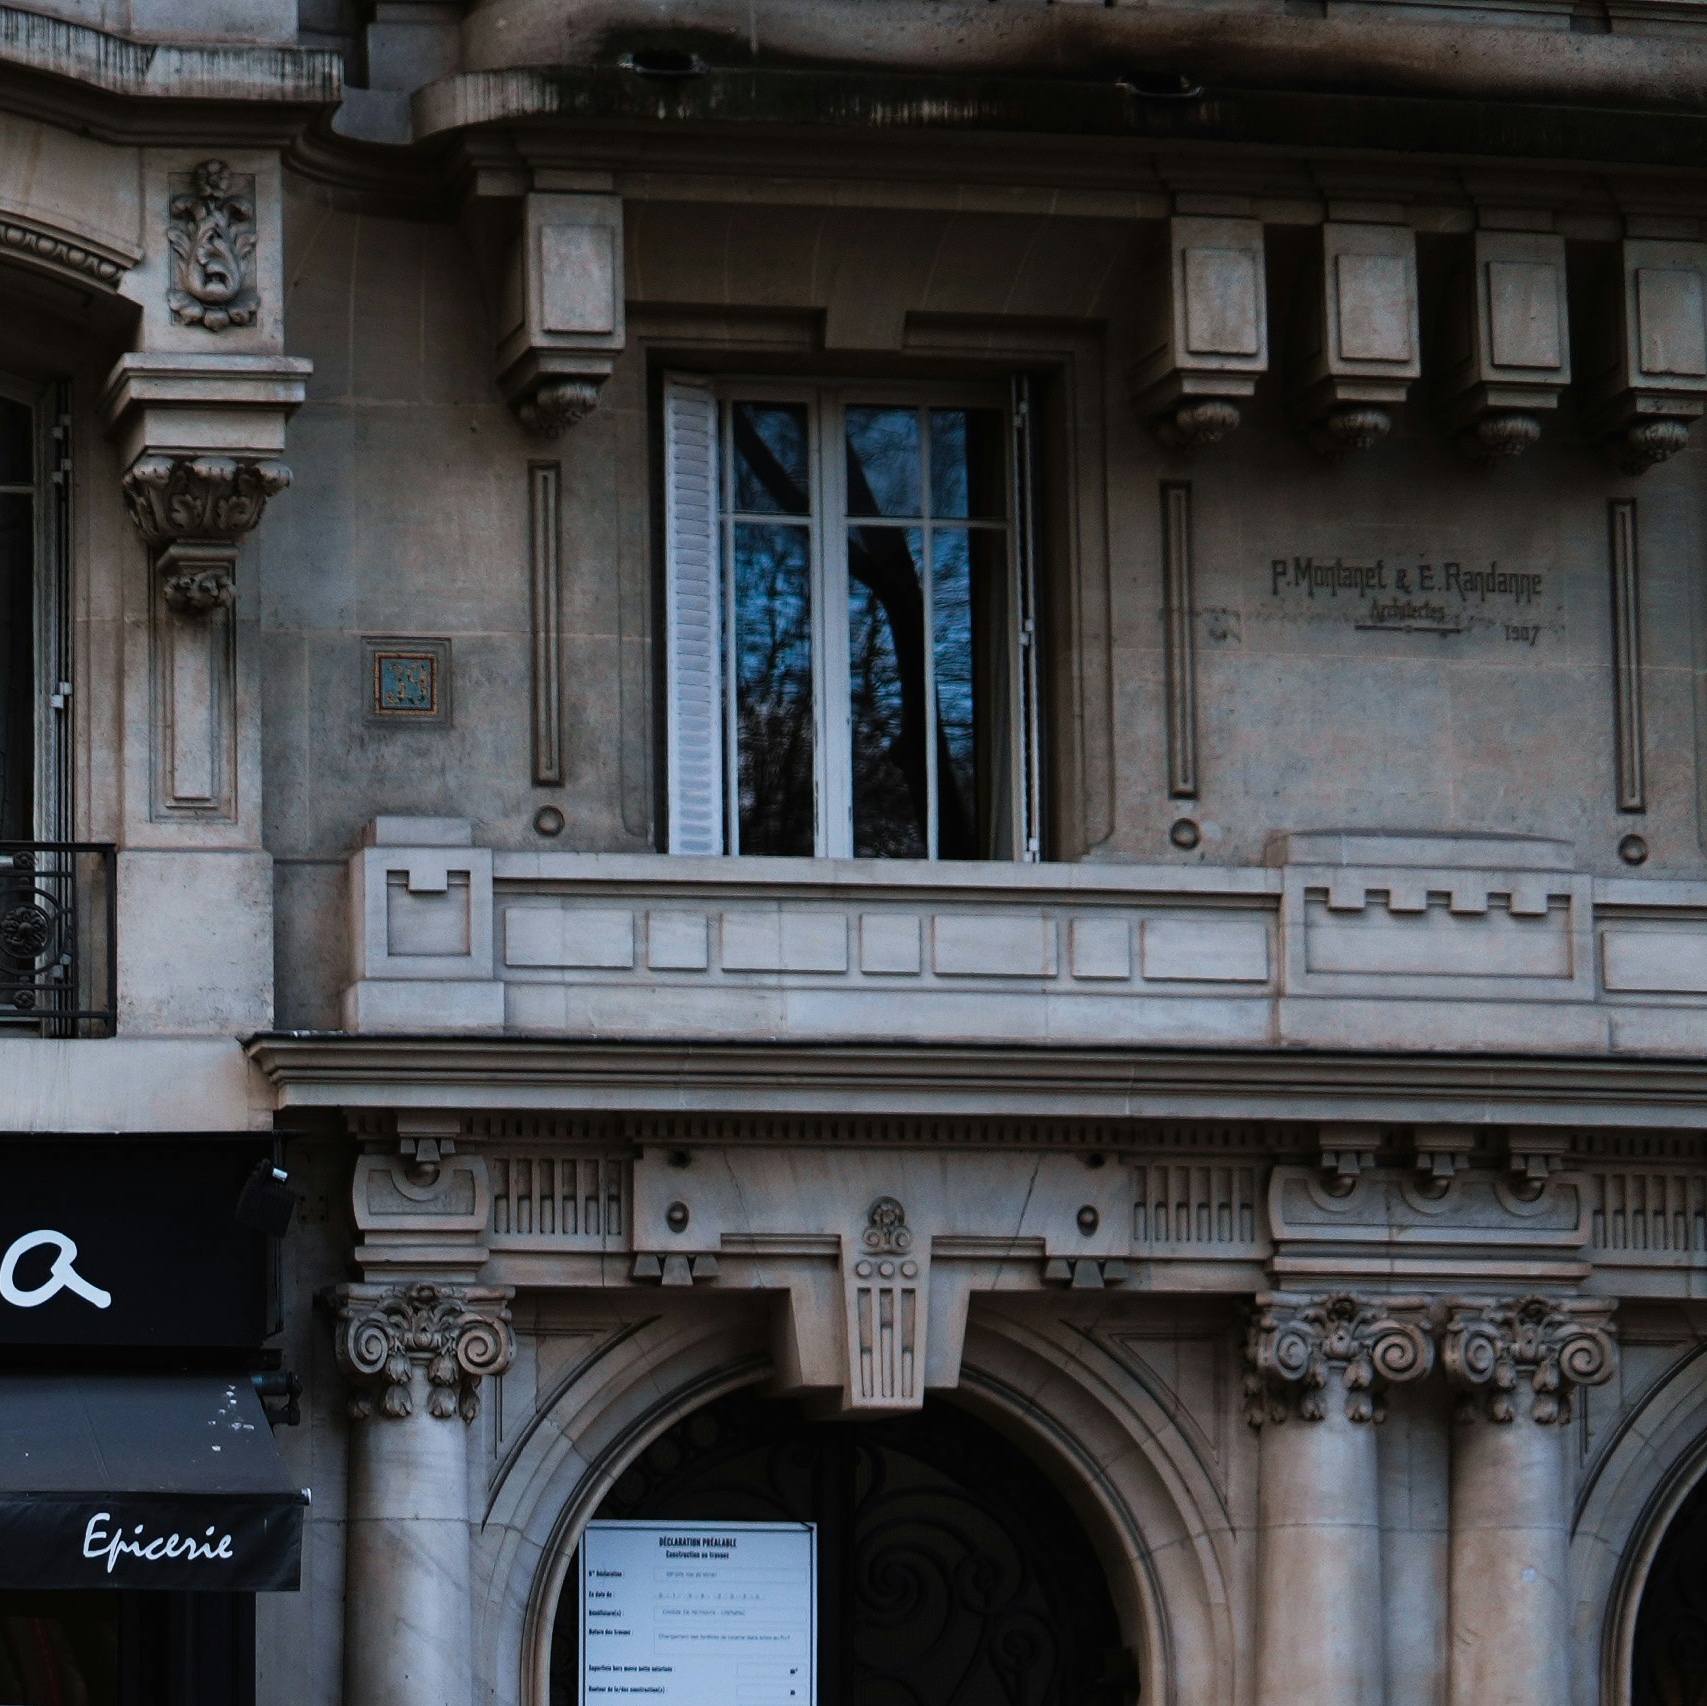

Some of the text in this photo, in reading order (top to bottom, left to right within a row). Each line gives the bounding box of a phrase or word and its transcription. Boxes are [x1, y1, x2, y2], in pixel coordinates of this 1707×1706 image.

[1395, 568, 1412, 594] &
[1504, 624, 1541, 646] 1907
[82, 1512, 233, 1574] Epicerie
[659, 1536, 737, 1548] DÉCLARATION PRÉALABLE
